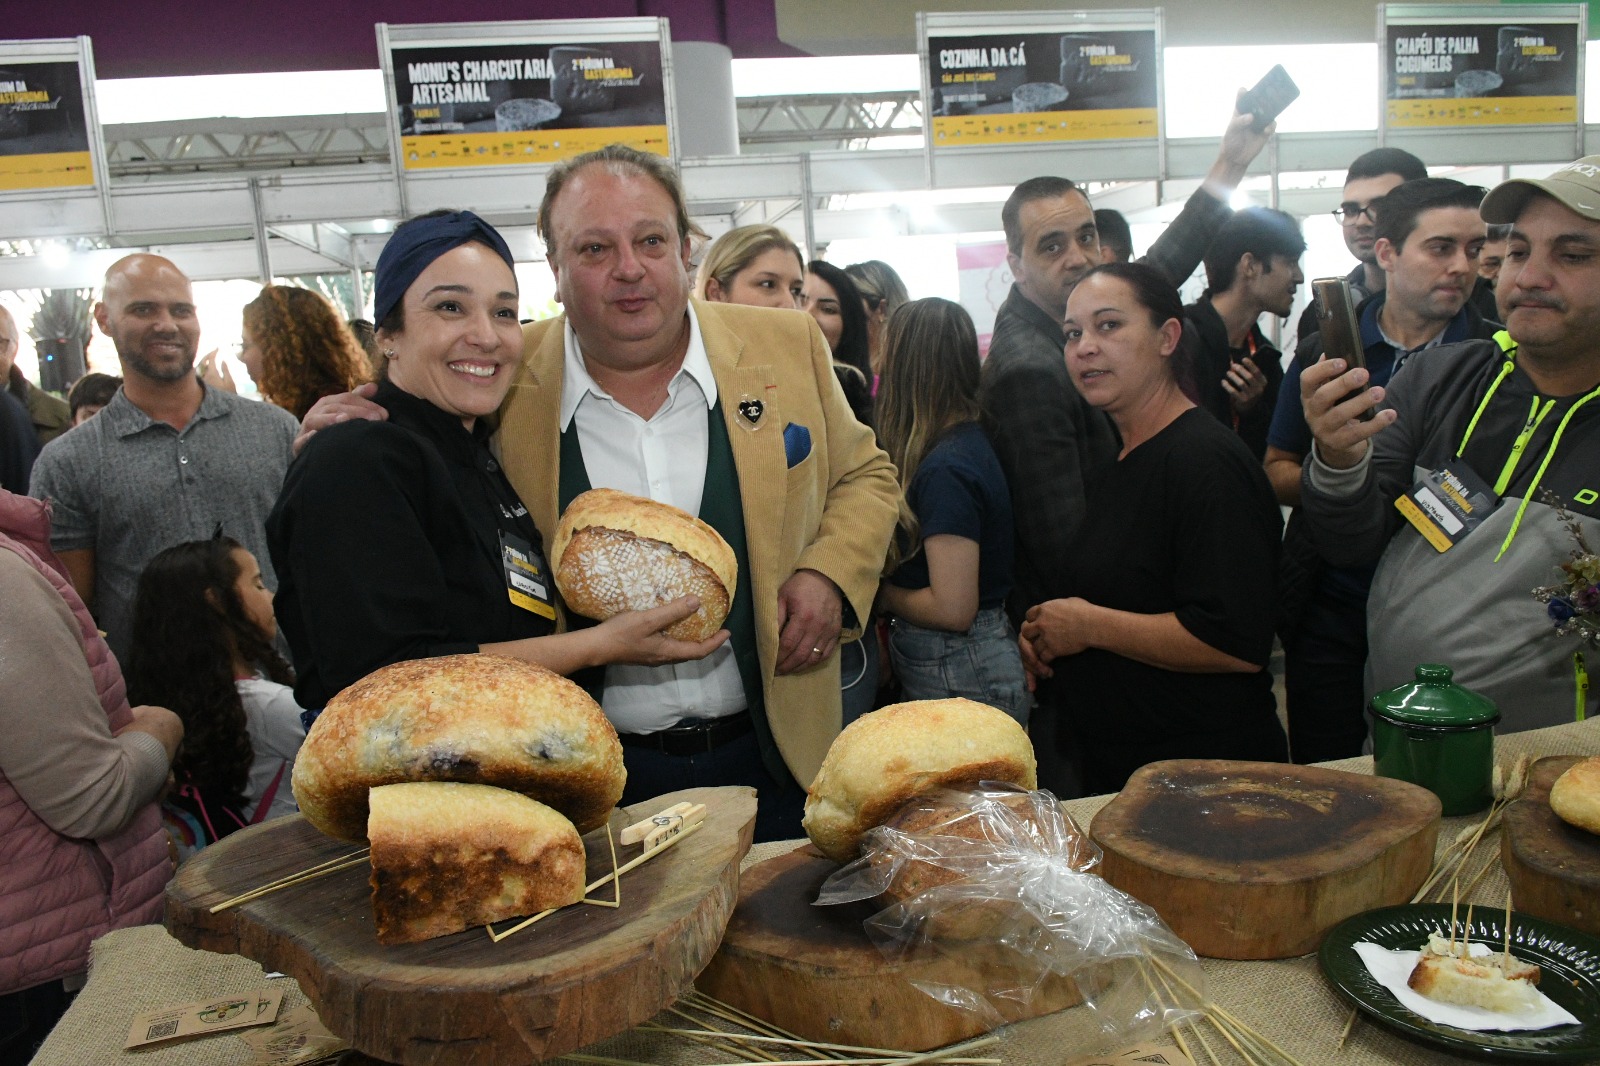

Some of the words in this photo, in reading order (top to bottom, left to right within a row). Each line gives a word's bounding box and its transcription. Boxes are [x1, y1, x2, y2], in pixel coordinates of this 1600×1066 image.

[940, 48, 989, 69] COZINHA
[991, 47, 1008, 67] DA
[1009, 41, 1027, 66] CÁ
[1395, 32, 1433, 55] CHAPÉU
[1434, 36, 1447, 54] DE
[1448, 36, 1479, 54] PALHA
[408, 61, 460, 84] MONU'S
[462, 58, 556, 81] CHARCUTARIA
[1395, 55, 1453, 73] COGUMELOS
[412, 81, 491, 105] ARTESANAL
